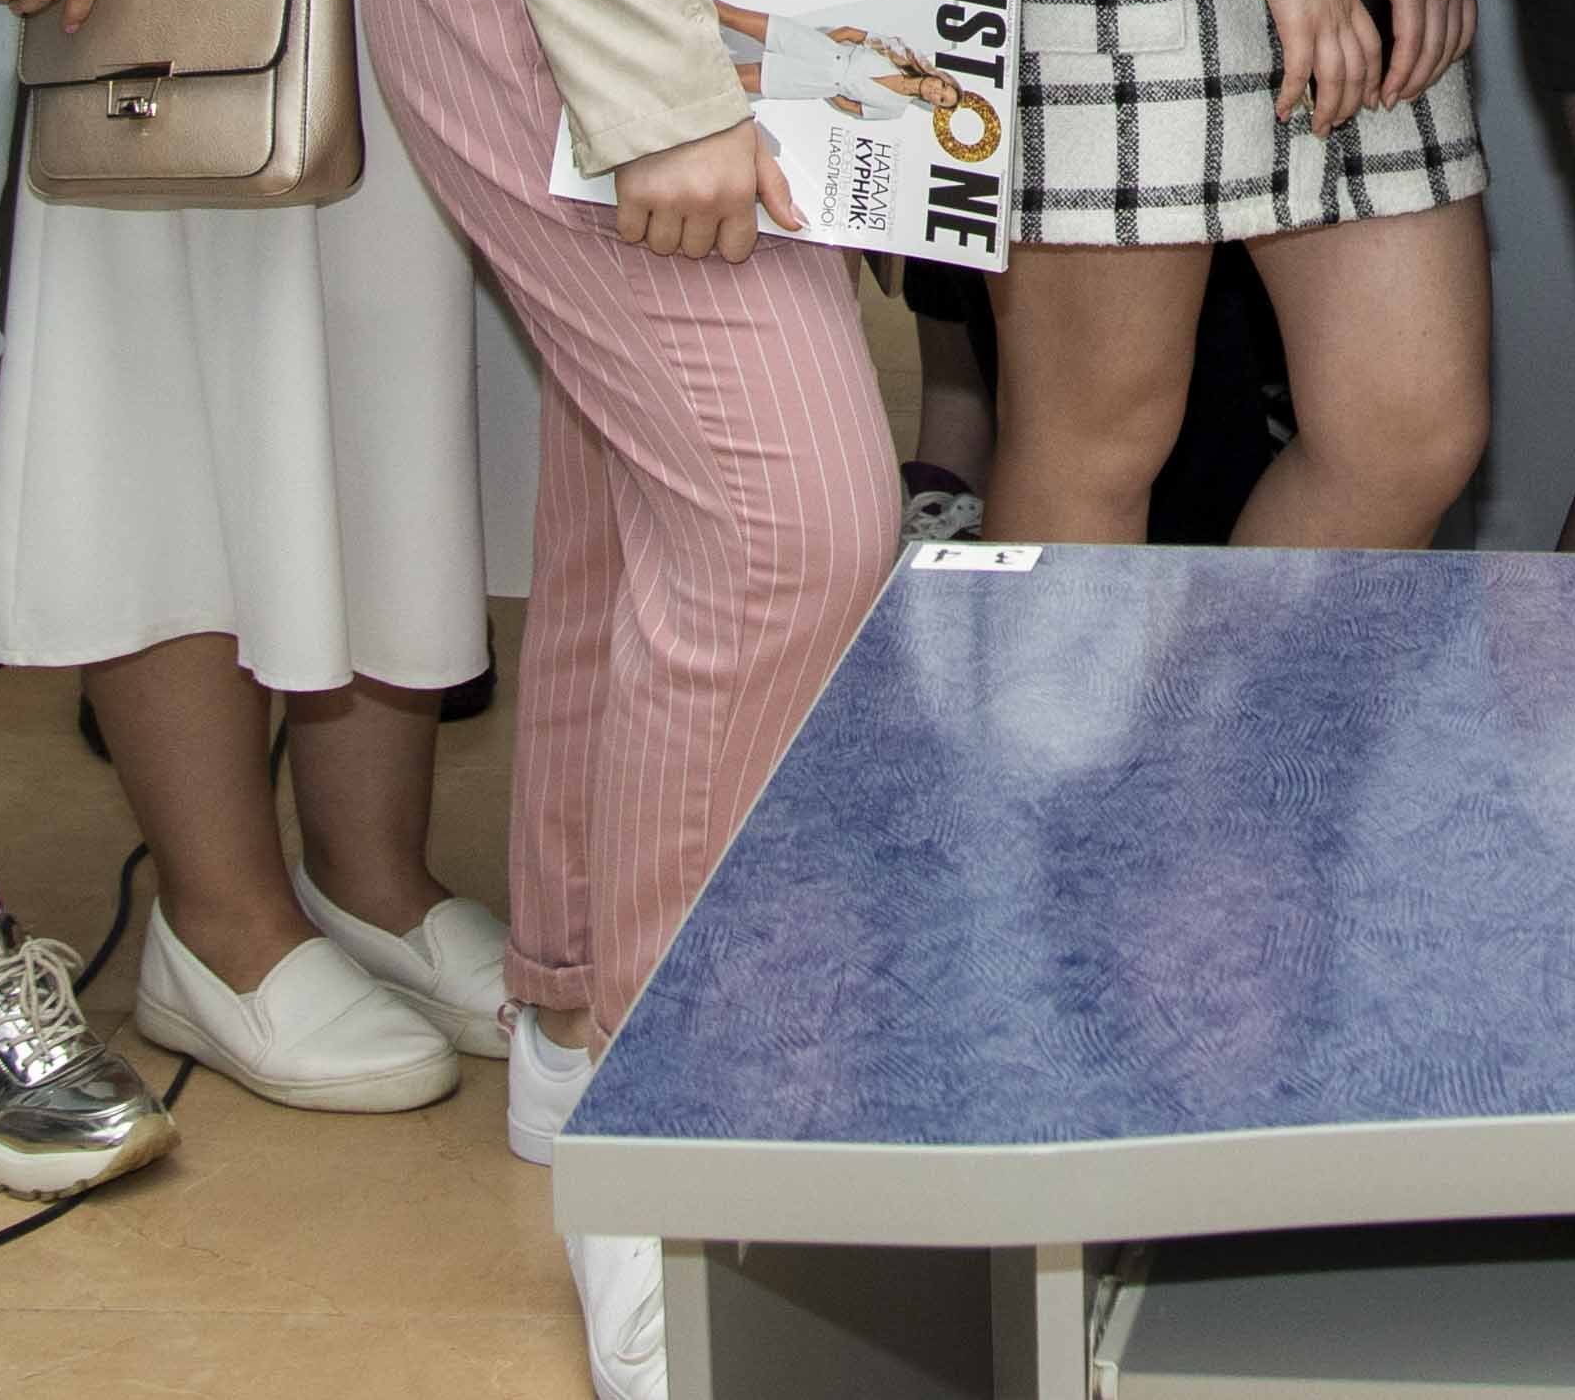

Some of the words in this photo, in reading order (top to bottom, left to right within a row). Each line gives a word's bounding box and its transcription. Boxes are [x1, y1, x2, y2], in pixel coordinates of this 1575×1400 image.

[847, 137, 873, 230] КУРНИК:
[867, 143, 891, 230] НАТАЛІЯ
[923, 89, 1003, 258] ONE
